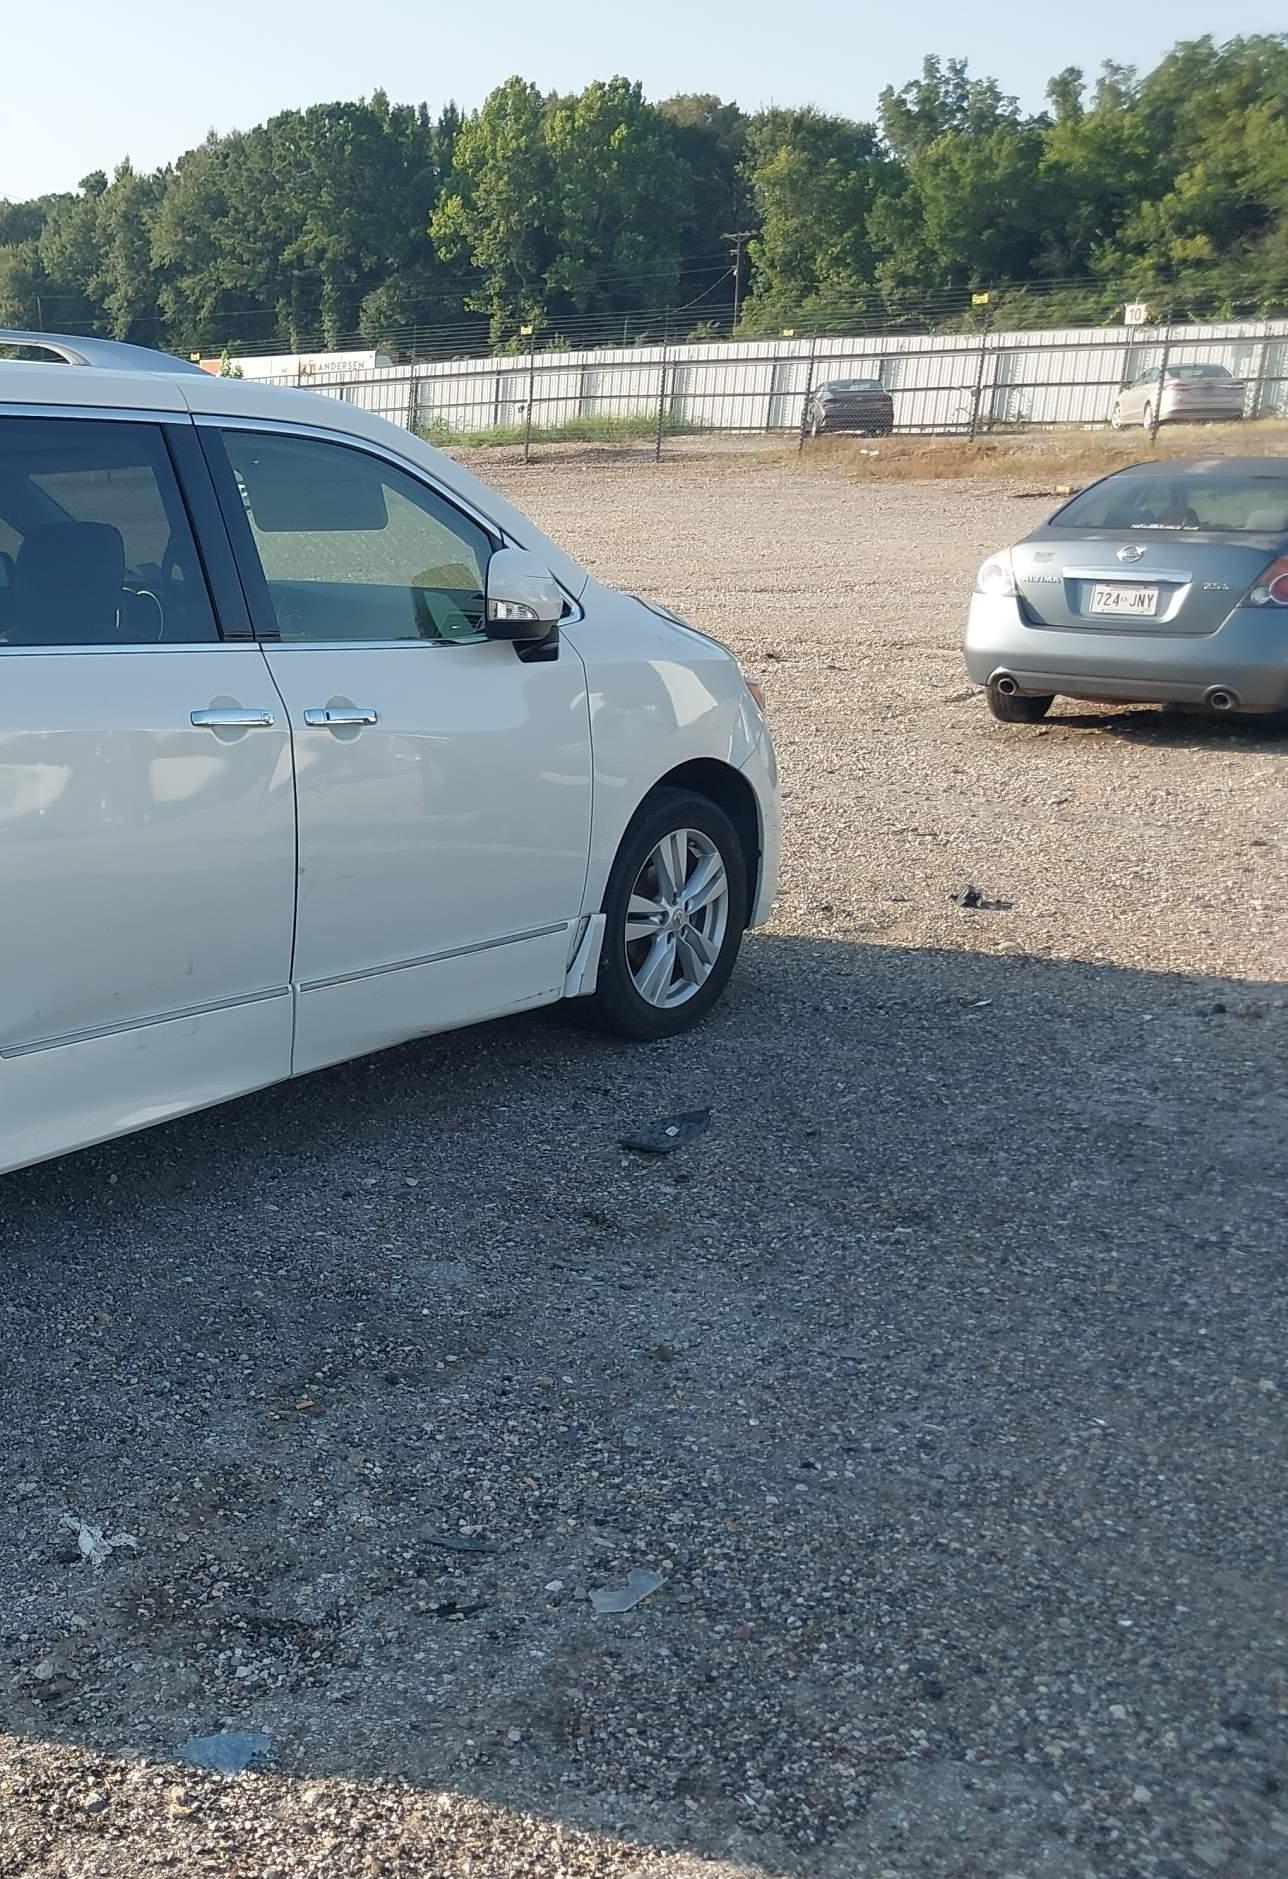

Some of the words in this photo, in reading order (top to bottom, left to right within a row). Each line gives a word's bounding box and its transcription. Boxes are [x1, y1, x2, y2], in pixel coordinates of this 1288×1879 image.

[1129, 308, 1142, 321] 10
[318, 360, 365, 371] ANDERSEN
[1096, 591, 1120, 607] 724
[1129, 593, 1155, 608] JNY
